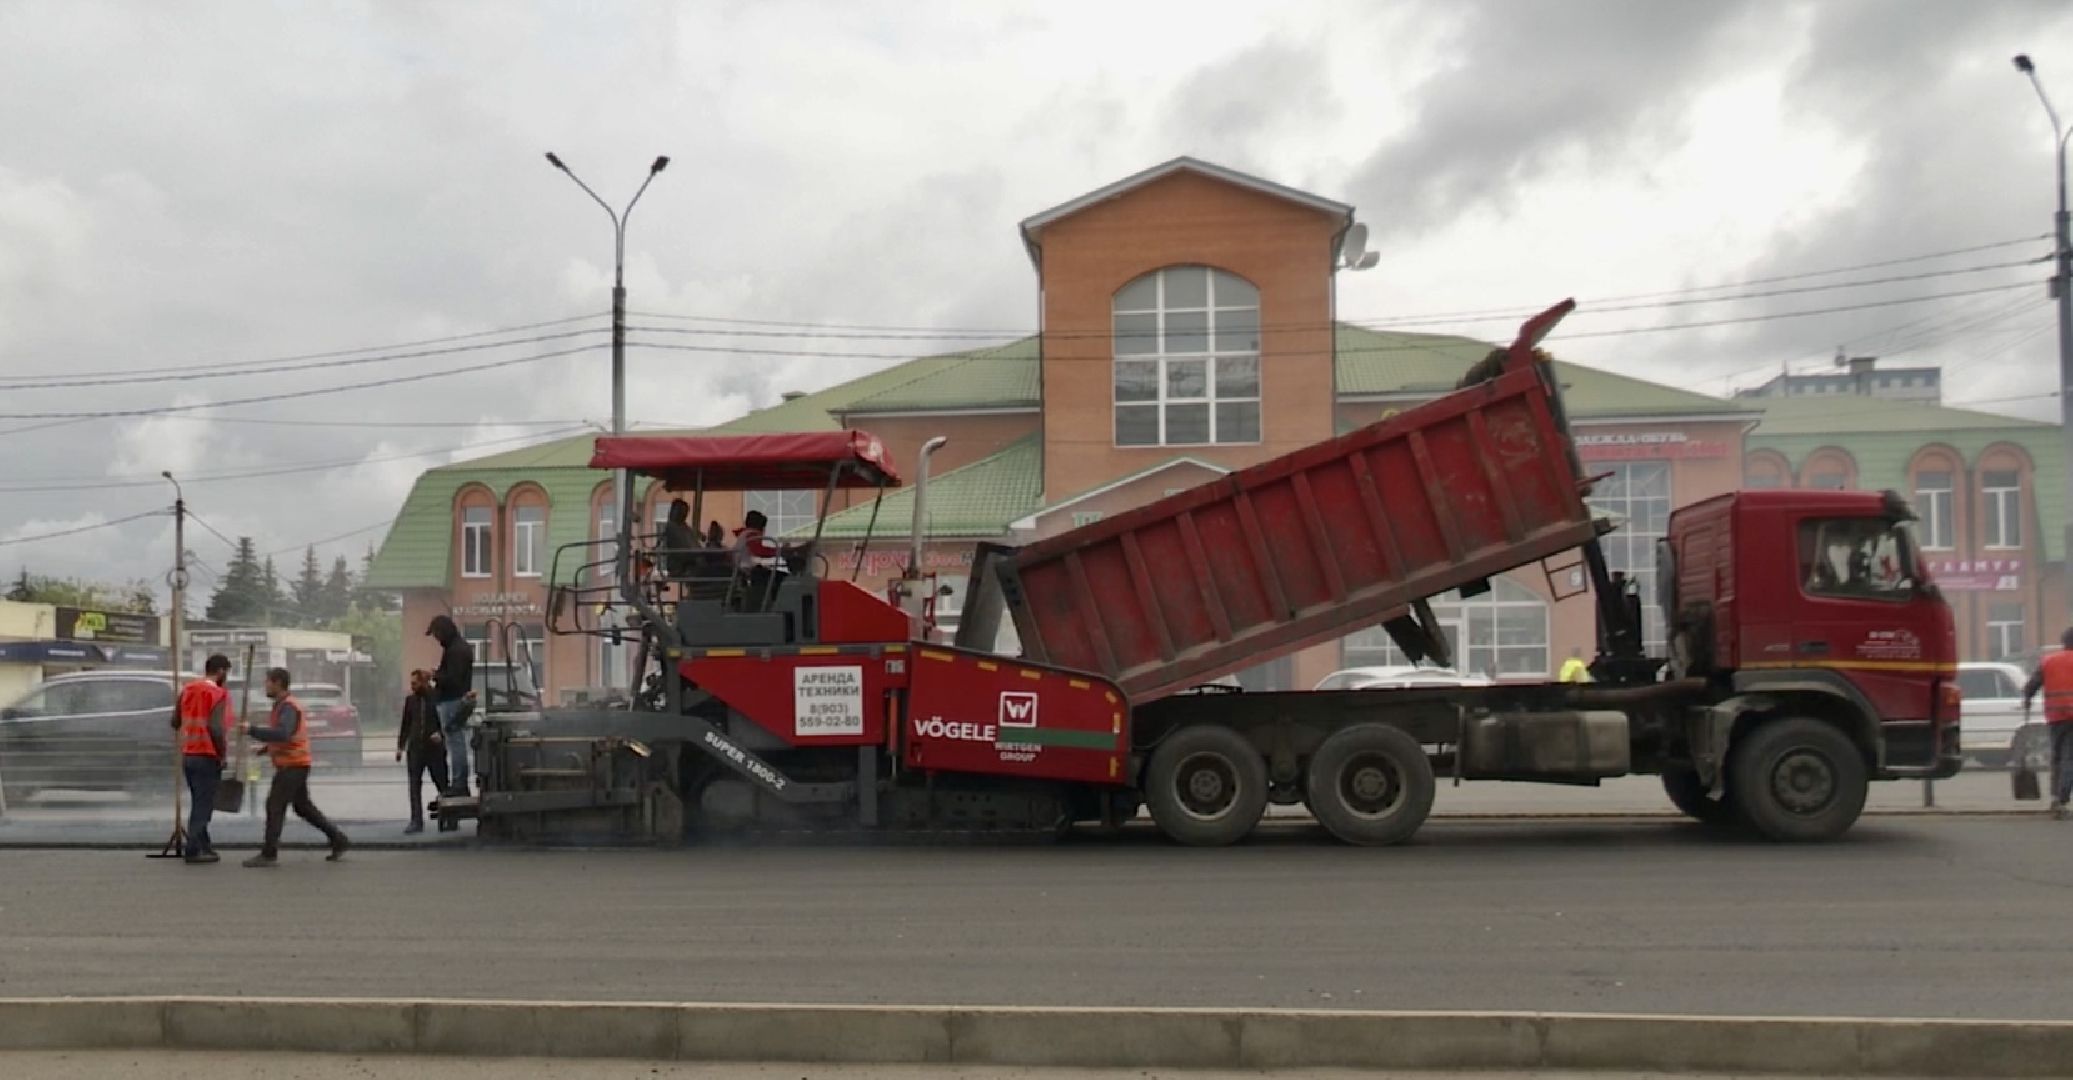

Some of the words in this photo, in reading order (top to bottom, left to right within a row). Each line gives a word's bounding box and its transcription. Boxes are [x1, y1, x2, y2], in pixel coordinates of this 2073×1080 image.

[802, 672, 856, 684] АРЕНДА
[798, 686, 859, 698] ТЕХНИКИ
[810, 703, 848, 715] 8(903)
[914, 715, 997, 742] VÖGELE
[705, 731, 745, 763] SUPER
